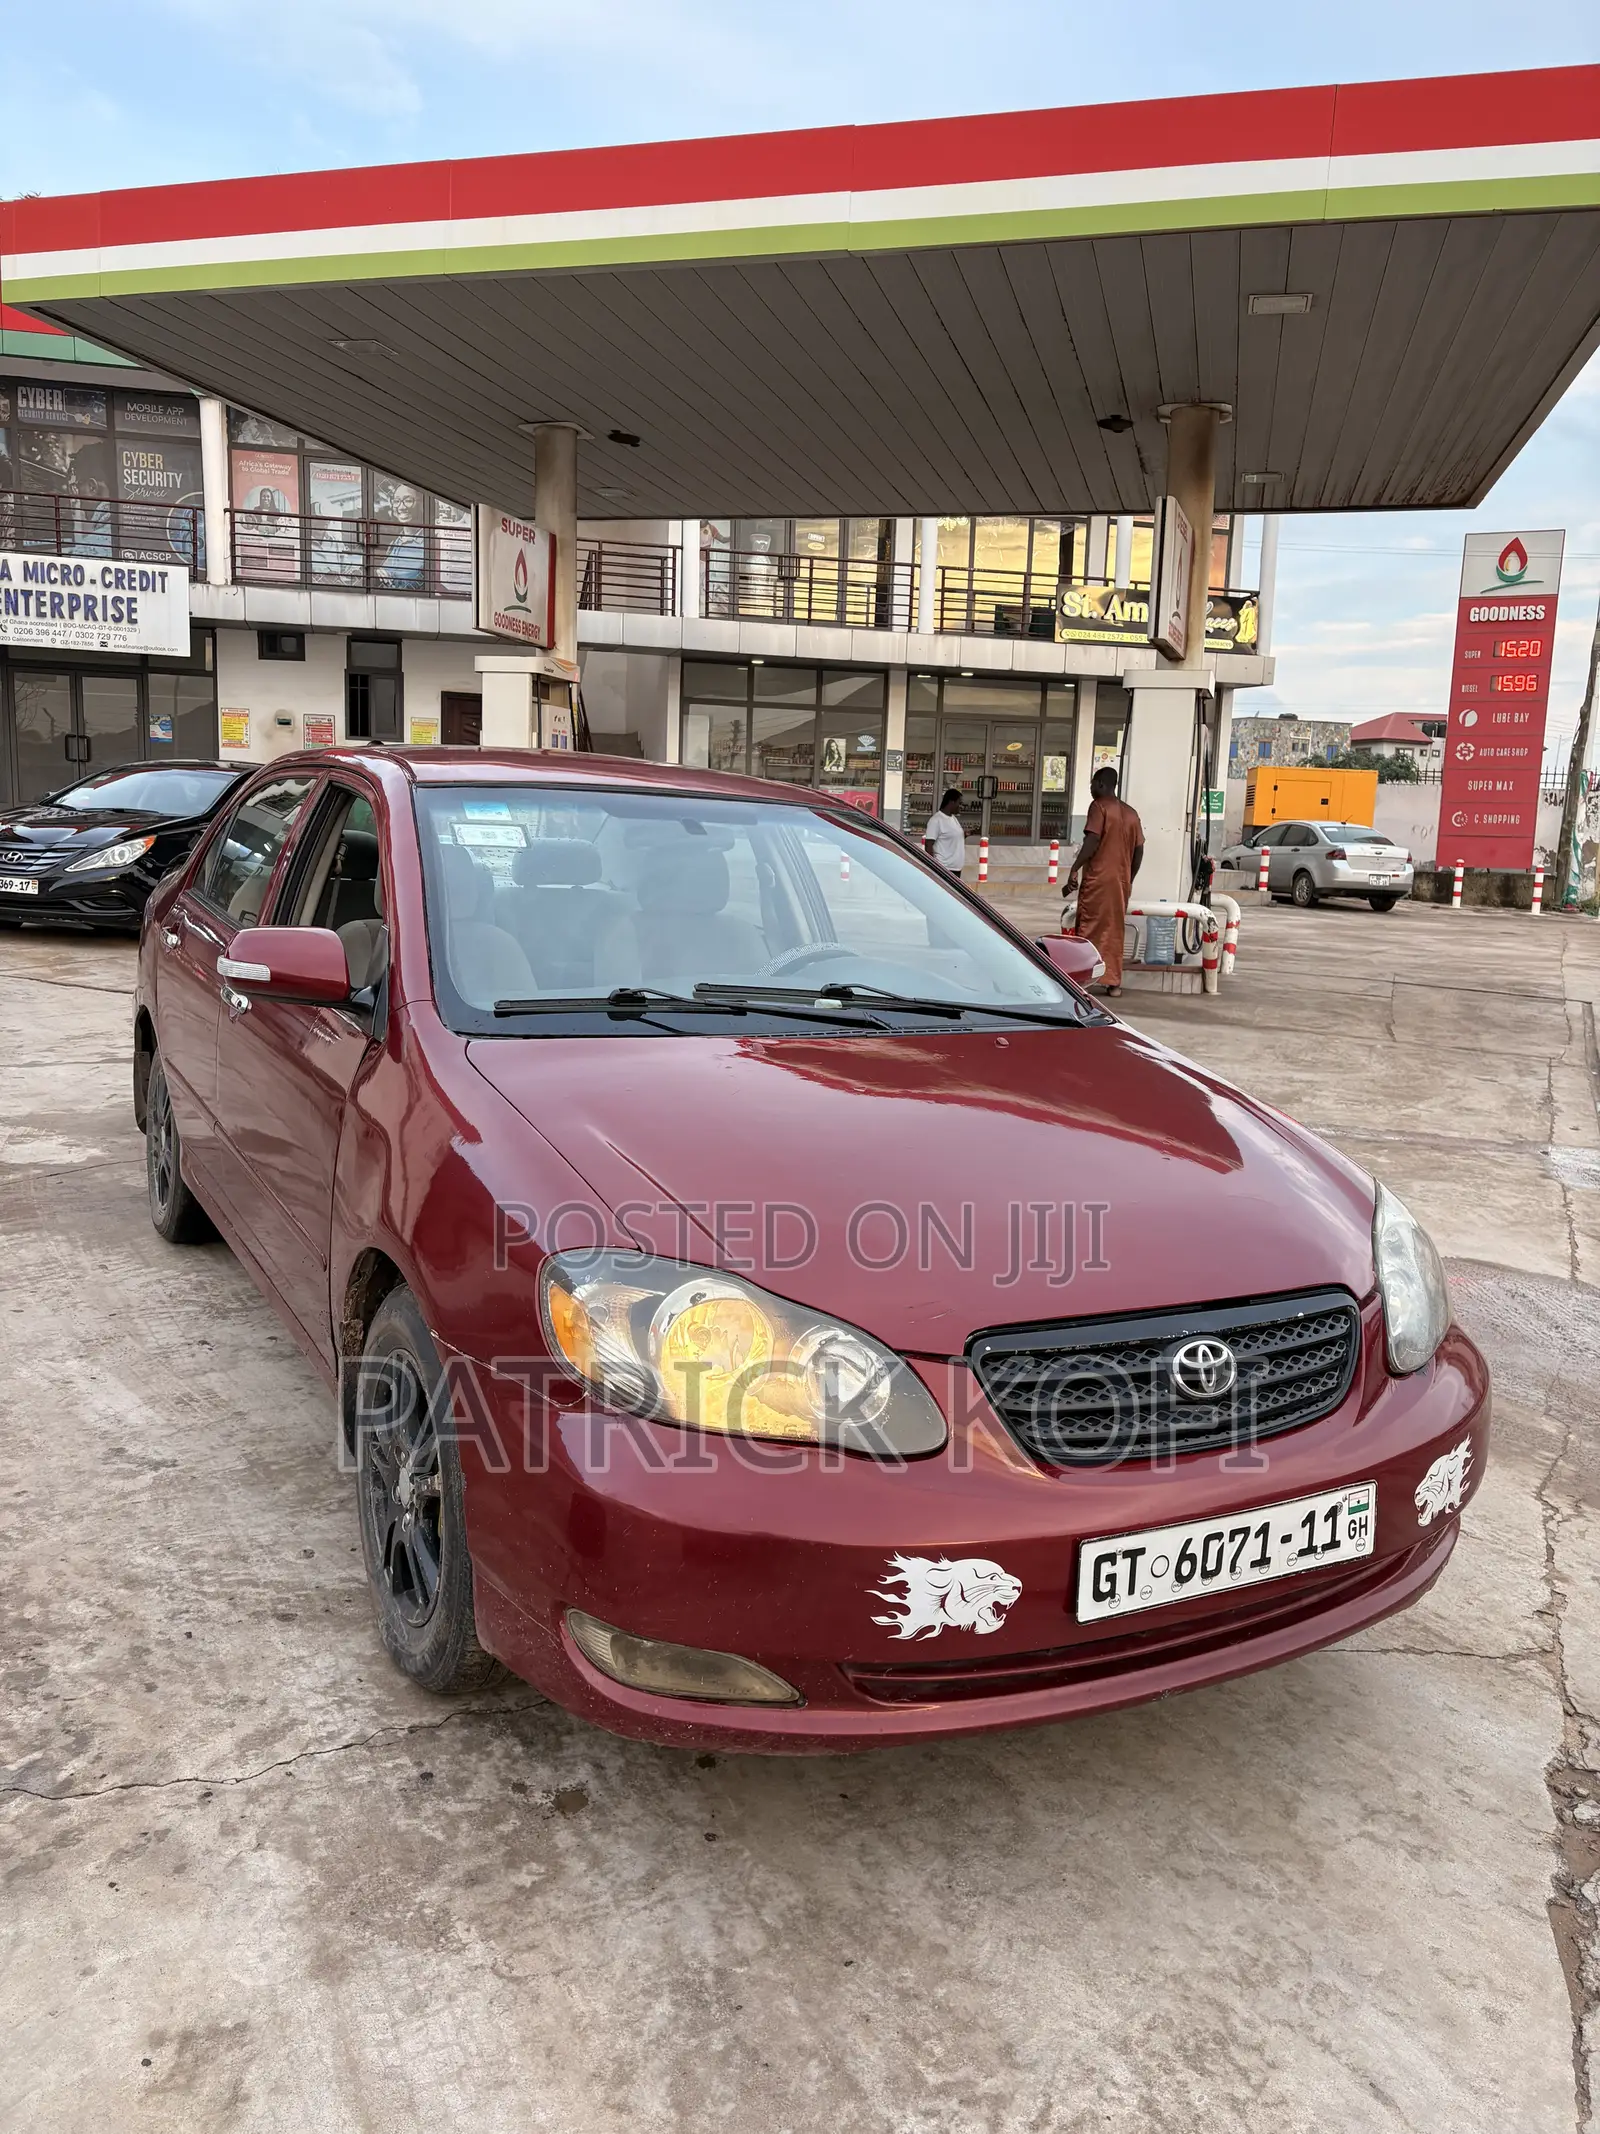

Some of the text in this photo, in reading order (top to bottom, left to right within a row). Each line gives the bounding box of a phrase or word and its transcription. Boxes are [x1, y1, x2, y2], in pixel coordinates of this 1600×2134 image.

[17, 386, 63, 411] CYBER
[18, 409, 44, 420] SECURITY
[46, 411, 68, 422] SERVICE
[127, 402, 184, 416] MOBILE APP
[125, 413, 187, 426] DEVELOPMENT
[122, 451, 163, 470] CYBER
[123, 469, 182, 489] SECURITY
[501, 517, 536, 545] SUPER
[139, 551, 172, 561] ACSCP
[0, 588, 138, 624] NTERPRISE
[1061, 591, 1098, 619] St.
[1469, 605, 1546, 622] GOODNESS
[494, 611, 541, 641] GOODNESS ENERGY
[13, 627, 34, 635] 0206
[52, 629, 67, 637] 447
[75, 631, 95, 639] 0302
[96, 633, 111, 641] 729
[113, 634, 128, 642] 776
[1464, 650, 1481, 659] SUPER
[1461, 684, 1479, 693] DIESEL
[1492, 712, 1530, 723] LUBE BAY
[1479, 747, 1495, 757] AUTO
[1467, 780, 1514, 791] SUPER MAX
[1483, 814, 1521, 825] SHOPPING
[1092, 1505, 1368, 1603] GT 6071-11 GH
